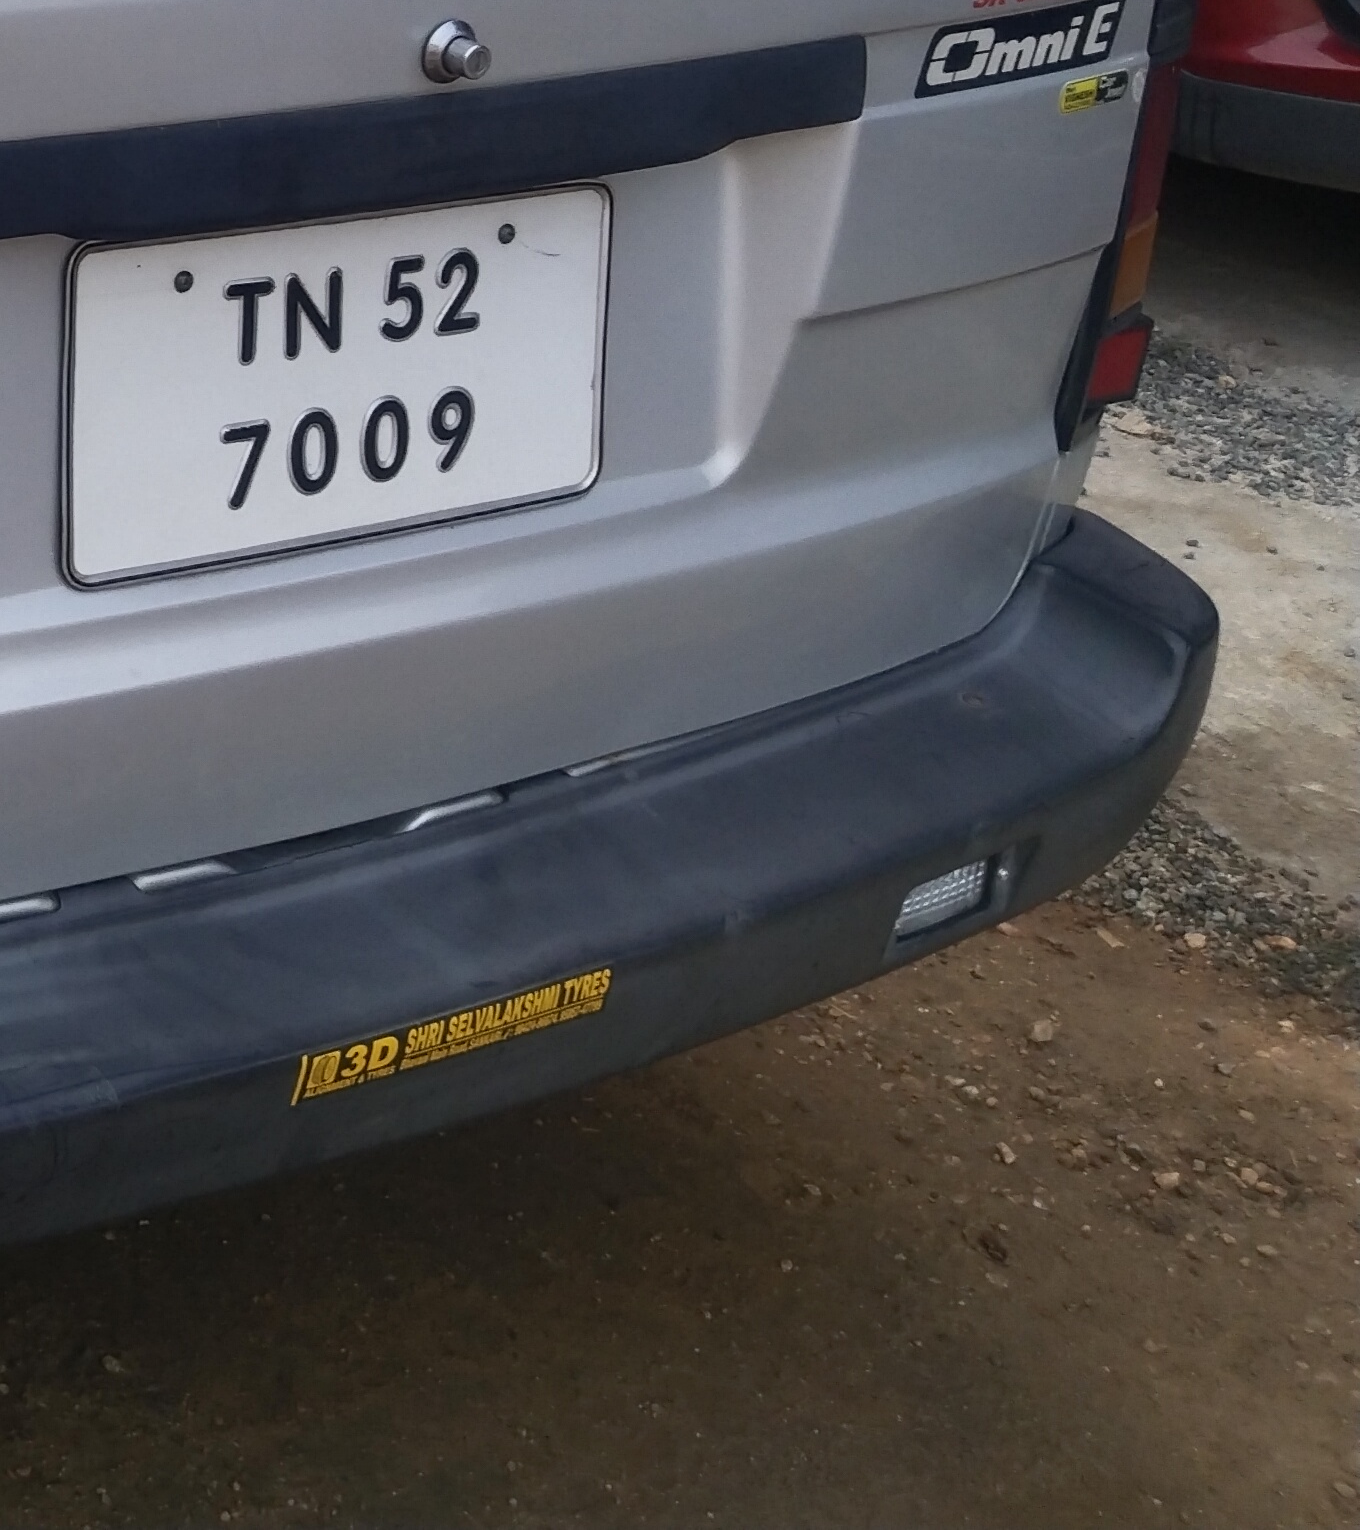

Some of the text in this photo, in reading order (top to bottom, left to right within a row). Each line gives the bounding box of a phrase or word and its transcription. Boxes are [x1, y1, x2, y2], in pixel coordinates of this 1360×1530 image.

[926, 1, 1120, 86] Omni E
[223, 247, 480, 365] TN 52
[220, 385, 476, 509] 7009
[341, 1036, 399, 1077] 3D
[404, 1020, 445, 1054] SHRI
[563, 968, 612, 1005] TYRES
